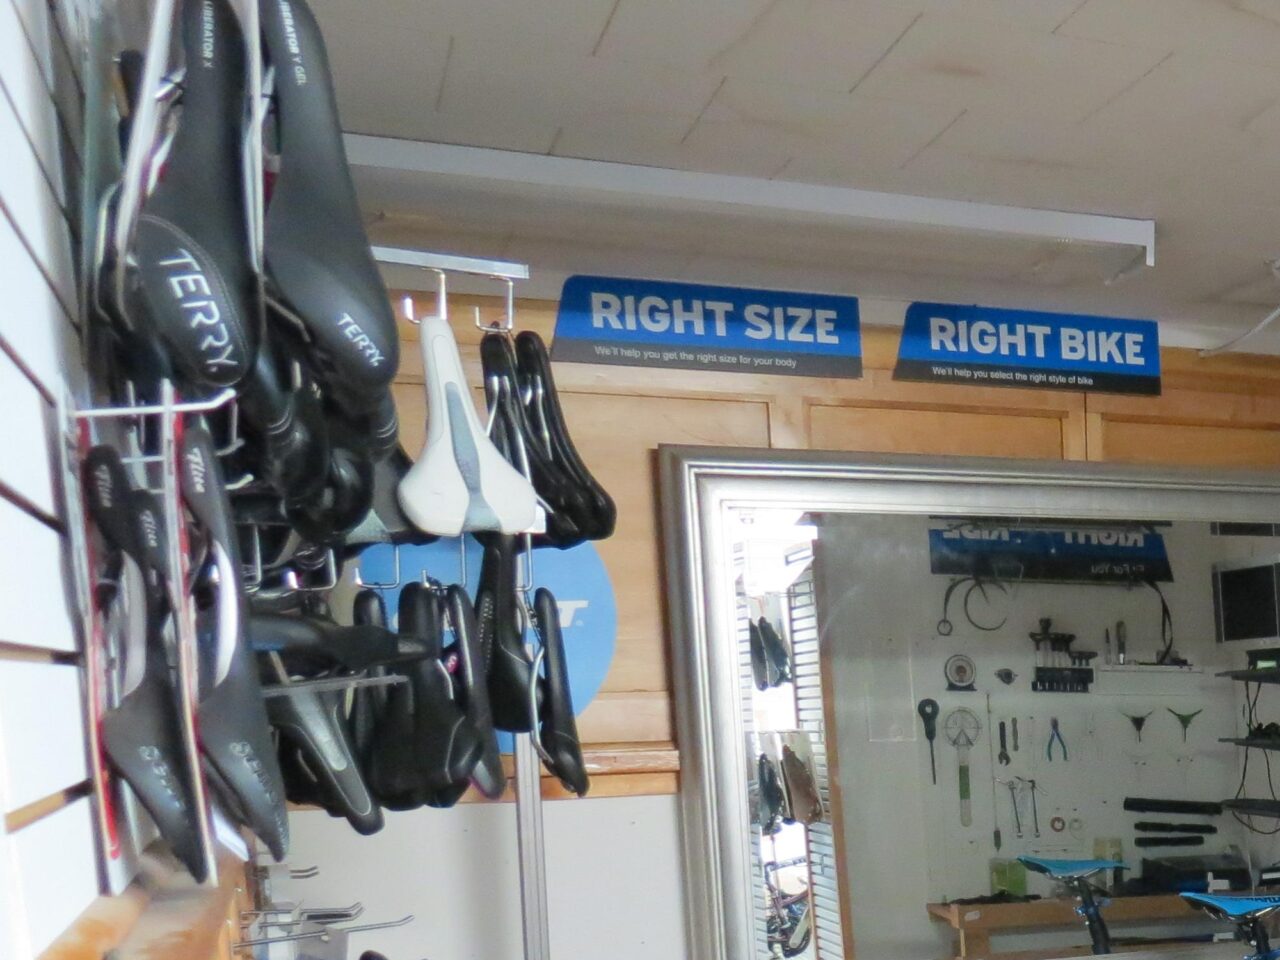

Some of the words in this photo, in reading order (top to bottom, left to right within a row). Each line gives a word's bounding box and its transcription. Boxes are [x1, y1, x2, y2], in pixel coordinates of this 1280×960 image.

[279, 0, 299, 54] IBERATOR
[159, 248, 239, 366] TERRY
[590, 291, 734, 337] RIGHT
[744, 303, 839, 345] SIZE
[337, 312, 384, 366] TERRY
[594, 345, 619, 356] We'll
[620, 347, 641, 359] help
[643, 350, 661, 361] you
[663, 350, 679, 362] get
[680, 350, 694, 361] the
[697, 352, 717, 364] right
[719, 353, 737, 364] size
[739, 354, 751, 365] for
[753, 357, 773, 367] your
[775, 356, 797, 368] body
[929, 316, 1051, 358] RIGHT
[1060, 327, 1146, 366] BIKE
[932, 366, 953, 376] We'll
[954, 367, 972, 379] help
[973, 369, 989, 380] you
[989, 369, 1014, 380] select
[1015, 370, 1028, 381] the
[1029, 372, 1047, 384] right
[1048, 373, 1067, 386] style
[1068, 375, 1076, 385] of
[1077, 375, 1094, 386] bike
